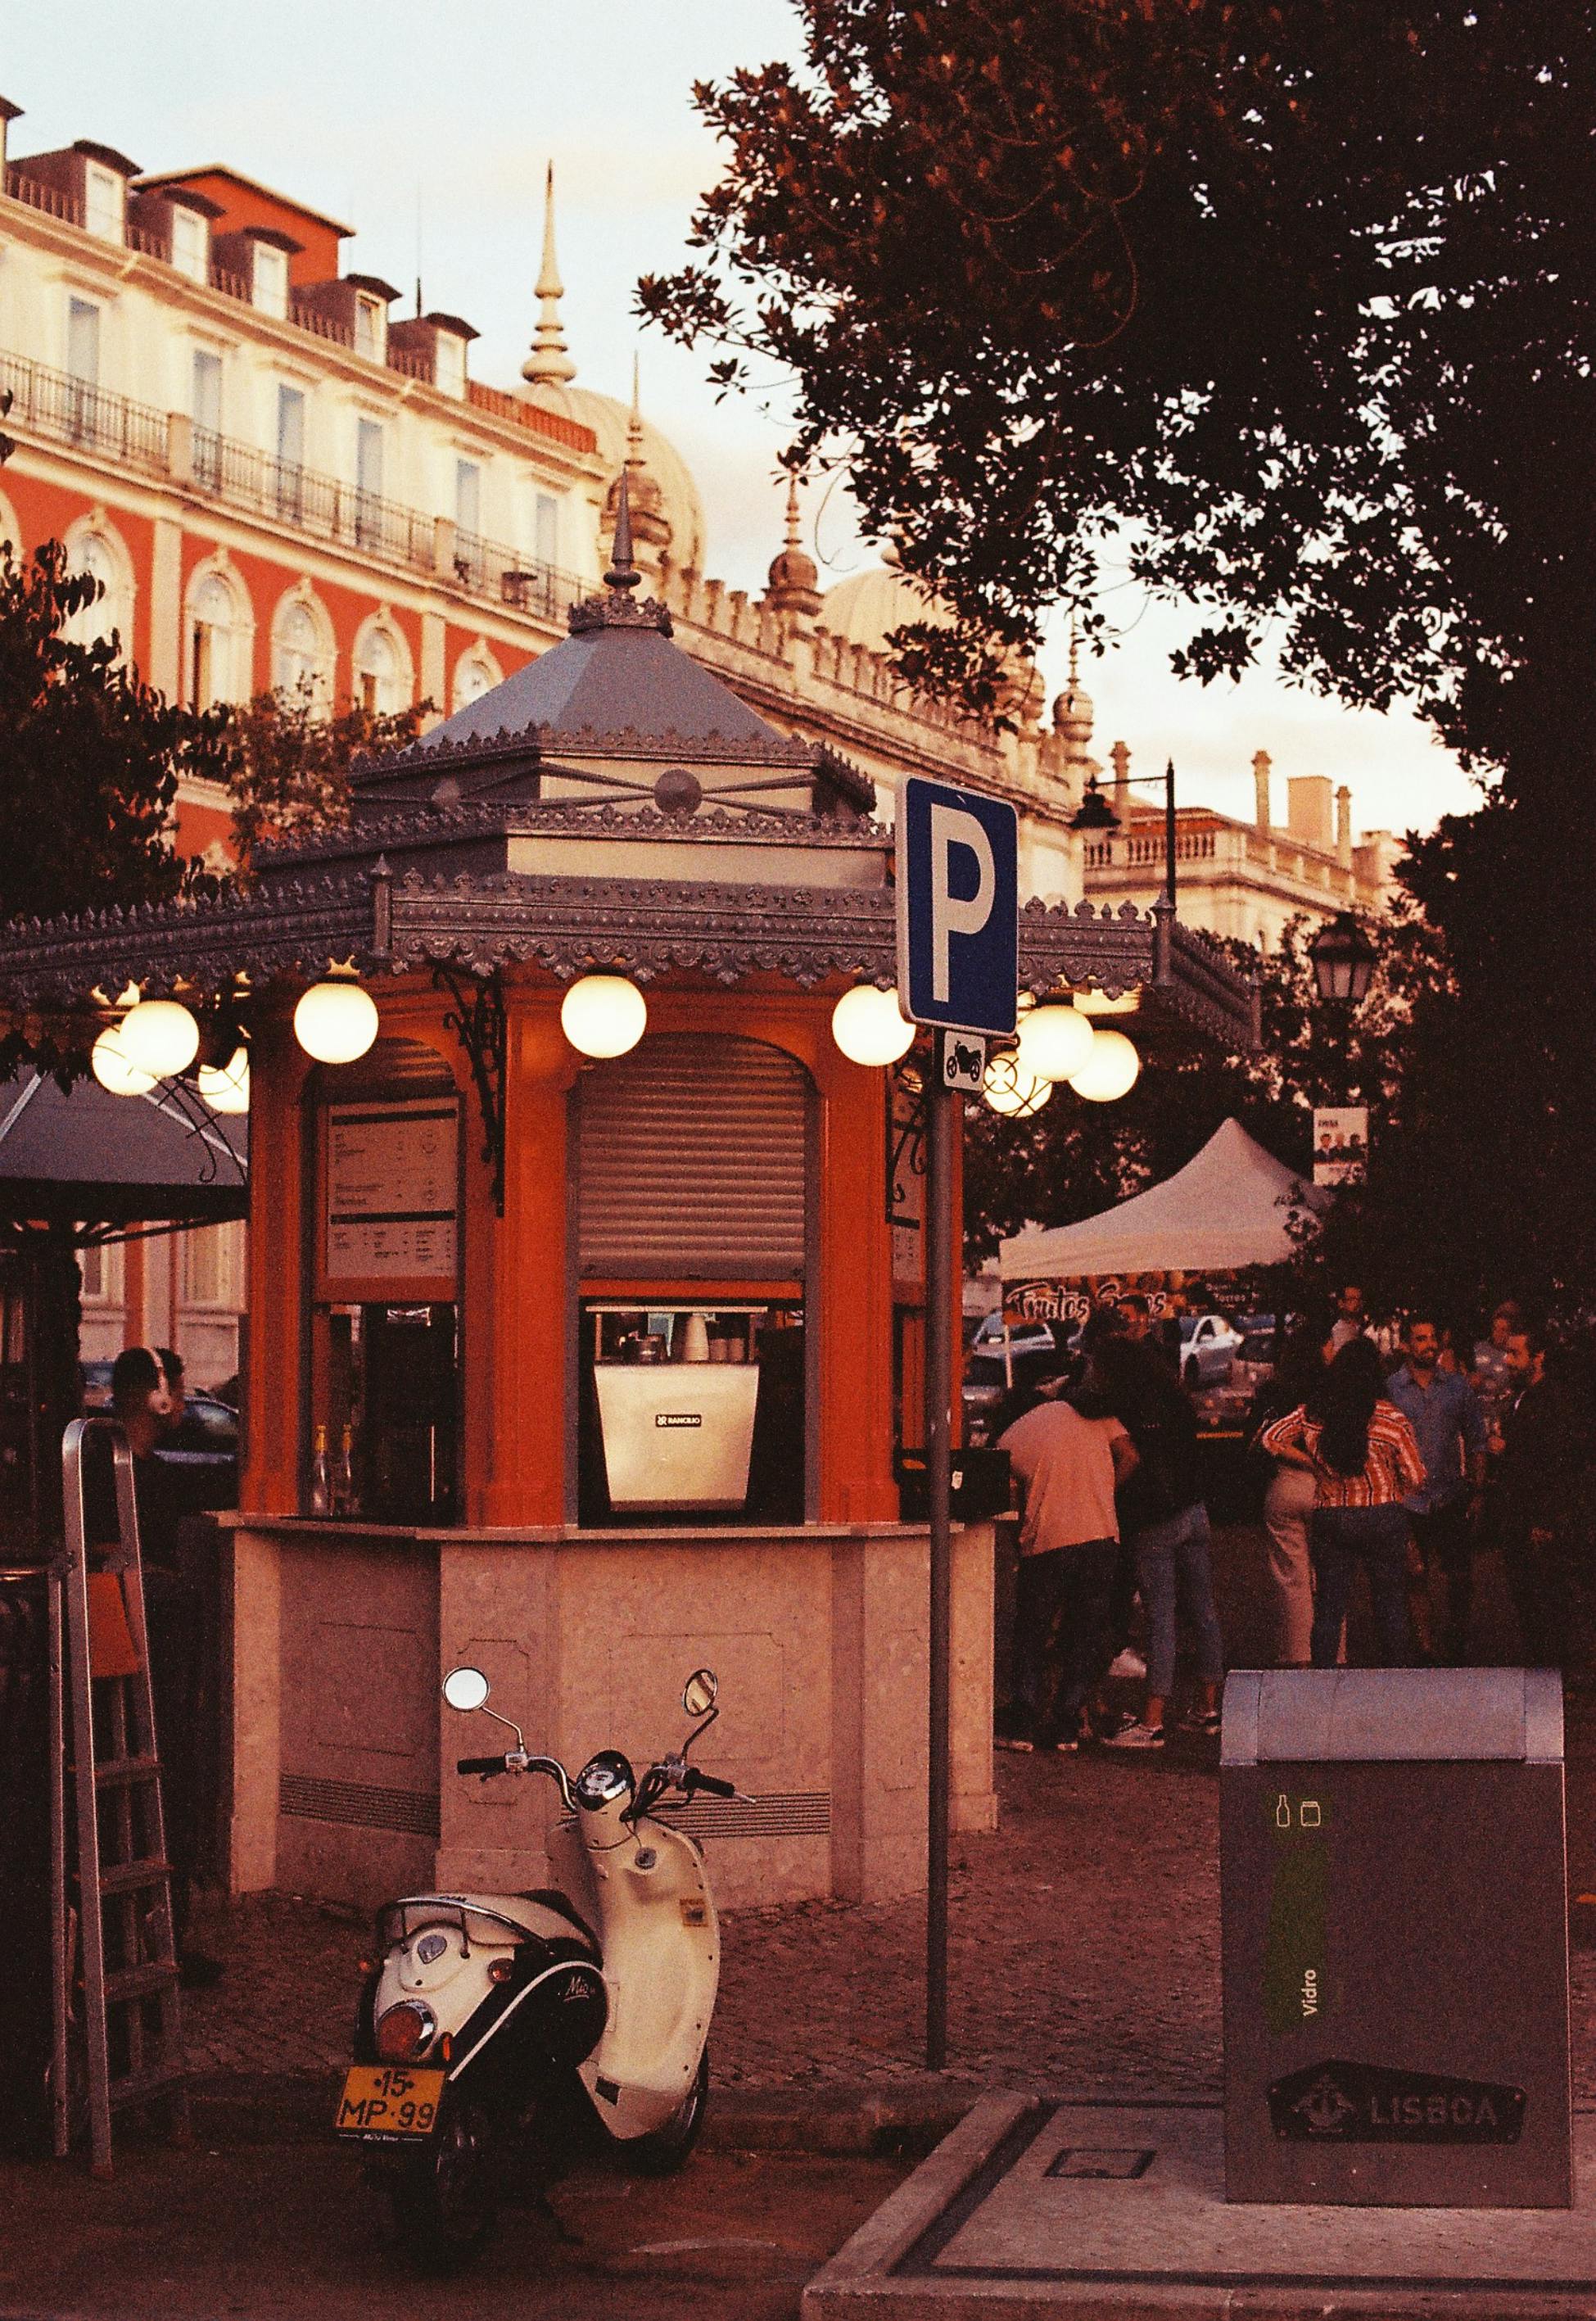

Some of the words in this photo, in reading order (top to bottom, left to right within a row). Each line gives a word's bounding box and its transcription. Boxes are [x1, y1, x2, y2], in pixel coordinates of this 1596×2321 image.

[931, 803, 995, 1002] P
[1301, 1969, 1318, 2016] Vidro
[1371, 2093, 1498, 2126] LISBOA
